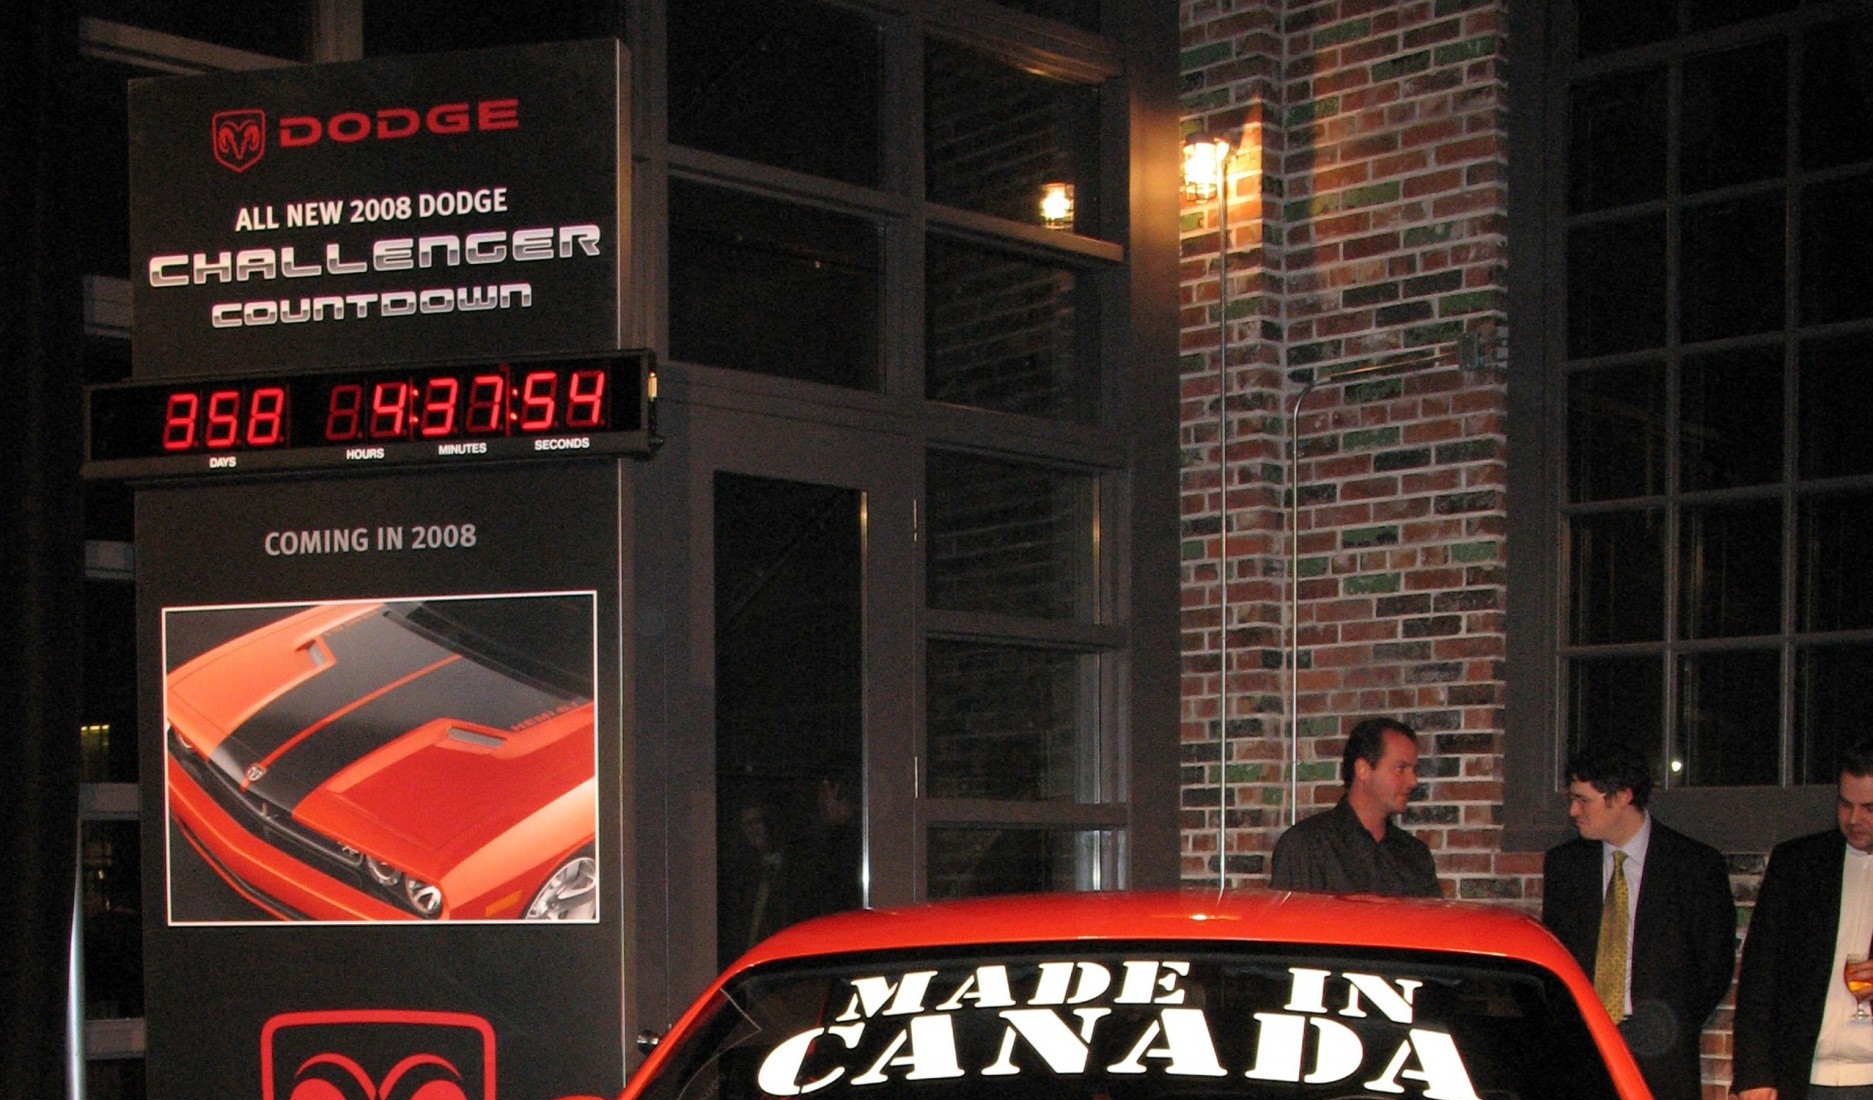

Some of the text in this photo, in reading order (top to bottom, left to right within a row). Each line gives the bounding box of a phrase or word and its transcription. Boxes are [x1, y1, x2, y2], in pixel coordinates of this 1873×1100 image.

[279, 98, 520, 148] DODGE
[235, 187, 508, 232] ALL NEW 2008 DODGE
[148, 224, 601, 288] CHALLENGER
[211, 282, 532, 328] COUNTDOWN
[163, 387, 285, 451] 358
[209, 437, 590, 469] DAYS HOURS MINUTES SECONDS
[264, 523, 477, 556] COMING IN 2008
[837, 959, 1423, 1025] MADE IN
